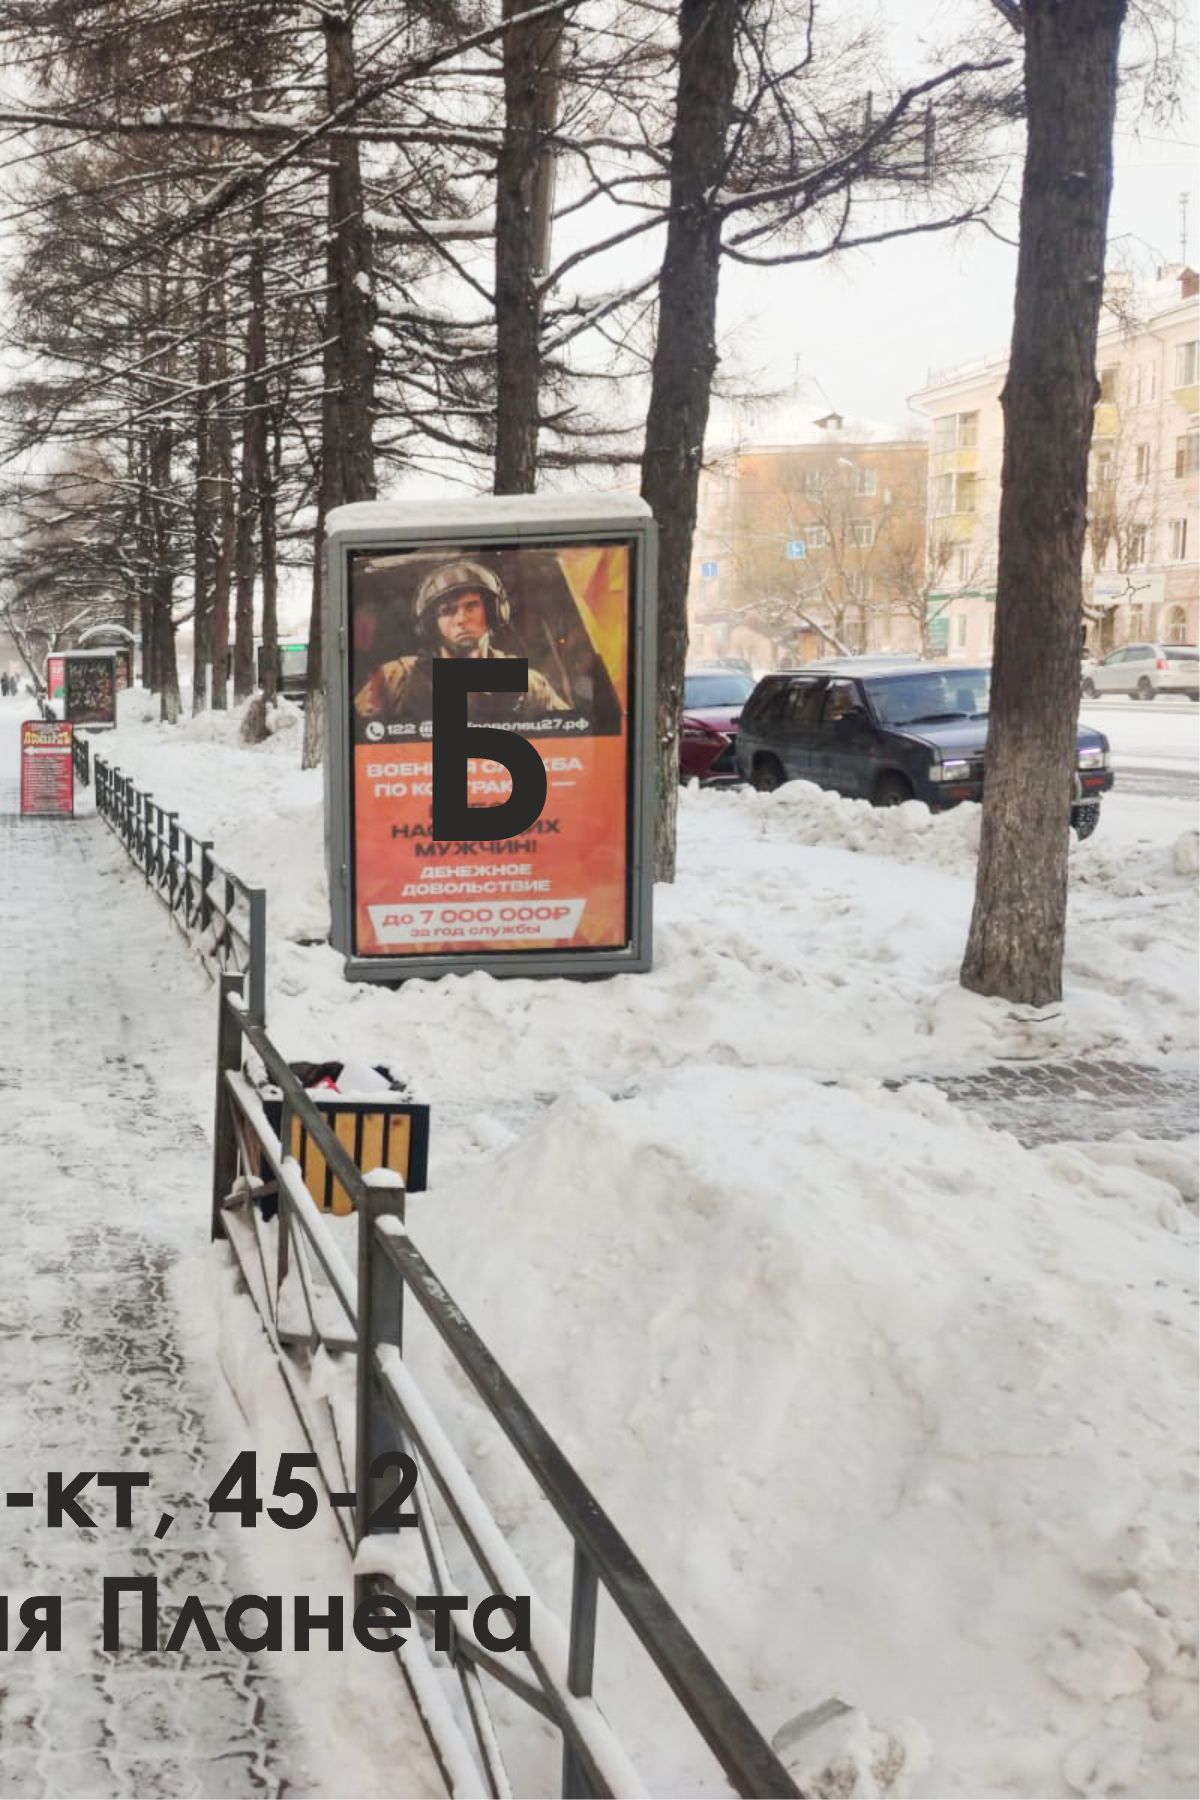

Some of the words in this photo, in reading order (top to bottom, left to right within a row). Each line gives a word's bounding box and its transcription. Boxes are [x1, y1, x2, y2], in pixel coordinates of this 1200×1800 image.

[388, 723, 417, 735] 122
[367, 760, 477, 778] ВОЕНЯ
[374, 783, 408, 798] ПО
[415, 840, 537, 857] МУЖЧИН!
[420, 864, 532, 880] ДЕНЕЖНОЕ
[401, 880, 552, 897] ДОВОЛЬСТВИЕ
[420, 909, 434, 925] 7
[410, 929, 431, 937] за
[433, 927, 465, 937] год
[469, 923, 541, 937] службы
